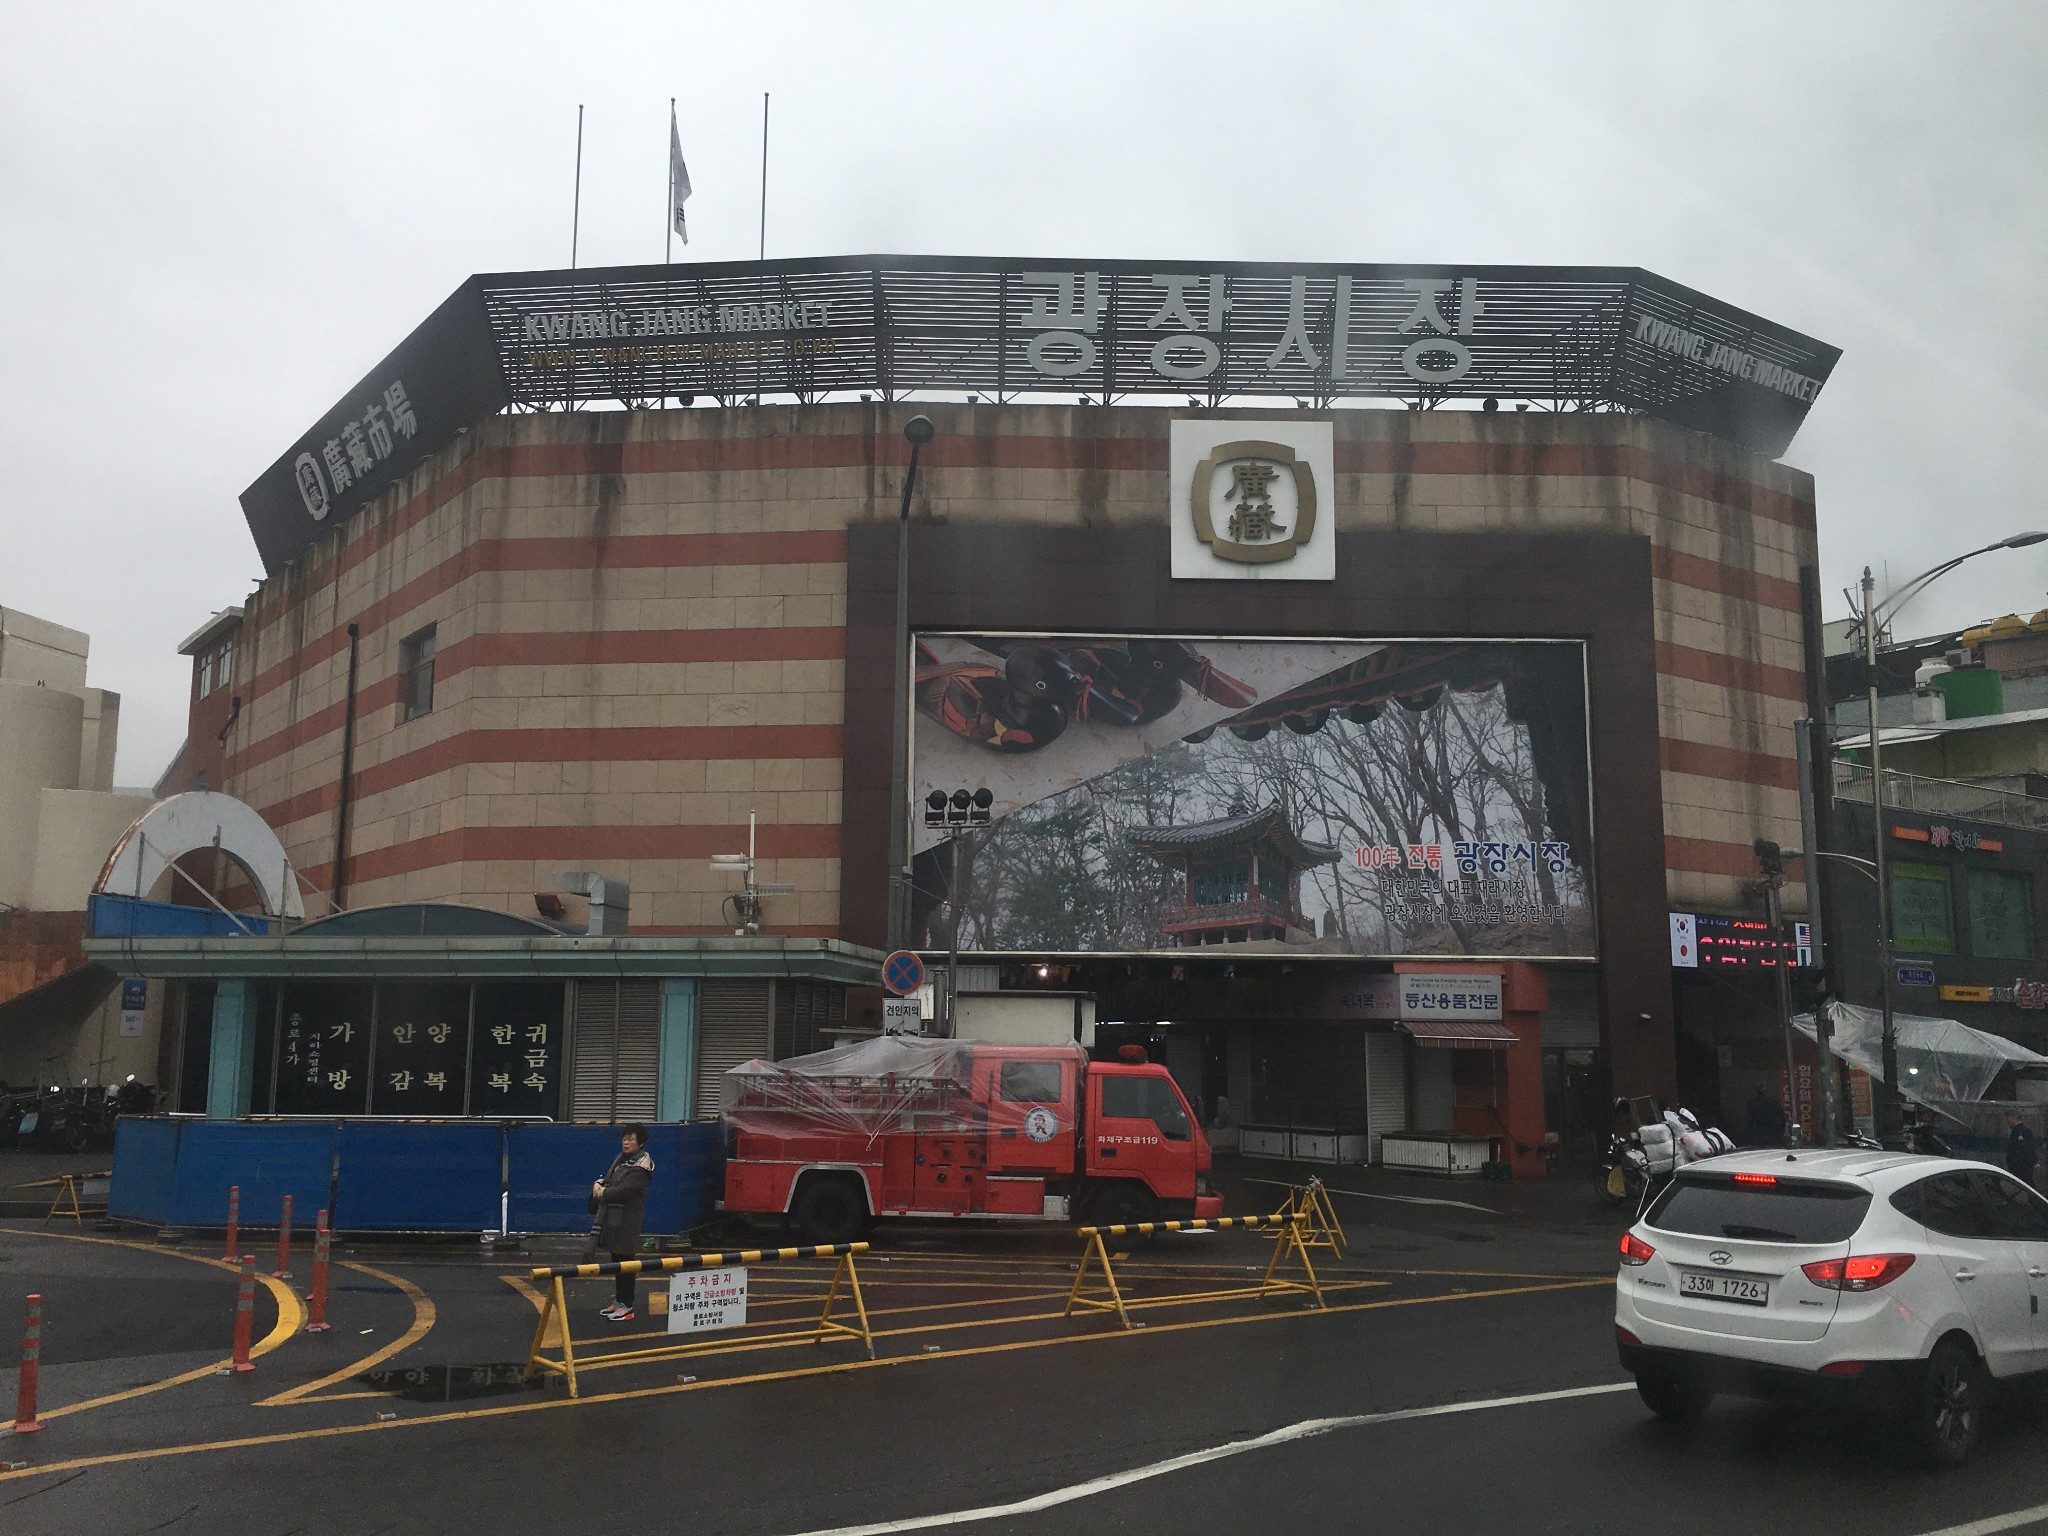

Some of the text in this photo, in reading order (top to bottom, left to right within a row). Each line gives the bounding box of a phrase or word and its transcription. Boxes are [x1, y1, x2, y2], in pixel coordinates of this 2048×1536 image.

[525, 302, 833, 341] KWANG JANG MARKET
[1020, 270, 1485, 383] 광장시장
[1635, 313, 1822, 402] KWANG JANG MARKET
[1354, 841, 1570, 873] 100年 전통 광장시장
[1381, 878, 1525, 897] 대한민국의 대표 재래시장
[1384, 903, 1571, 923] 광장시장에 오신것을 환영합니다.
[886, 1005, 919, 1017] 견인지역
[1405, 992, 1498, 1010] 등산용품전문
[286, 1013, 301, 1066] 종로4가
[327, 1022, 355, 1091] 가방
[522, 1022, 549, 1093] 귀금속
[688, 1273, 732, 1288] 주차금지
[1722, 1279, 1759, 1299] 1726
[673, 1297, 741, 1312] 청소차량 주차 구역입니다.
[675, 1294, 682, 1302] 이
[684, 1292, 701, 1302] 구역은
[703, 1288, 737, 1299] 긴급소방차량
